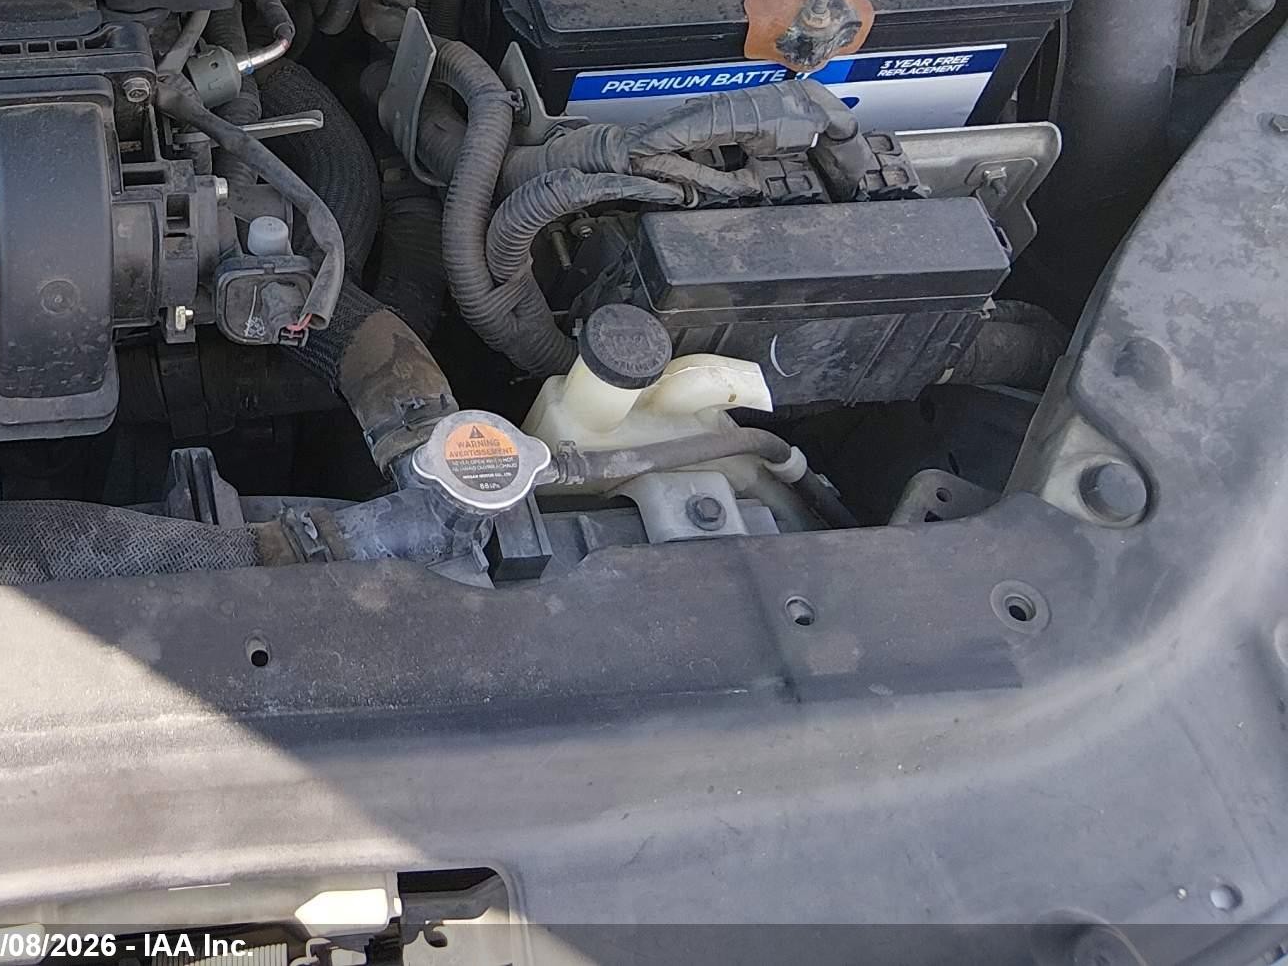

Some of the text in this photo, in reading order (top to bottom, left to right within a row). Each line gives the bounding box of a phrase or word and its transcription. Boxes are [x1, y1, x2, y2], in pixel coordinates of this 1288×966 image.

[880, 54, 974, 70] 3 YEAR FREE
[601, 74, 711, 94] PREMIUM
[456, 439, 500, 449] WARNING
